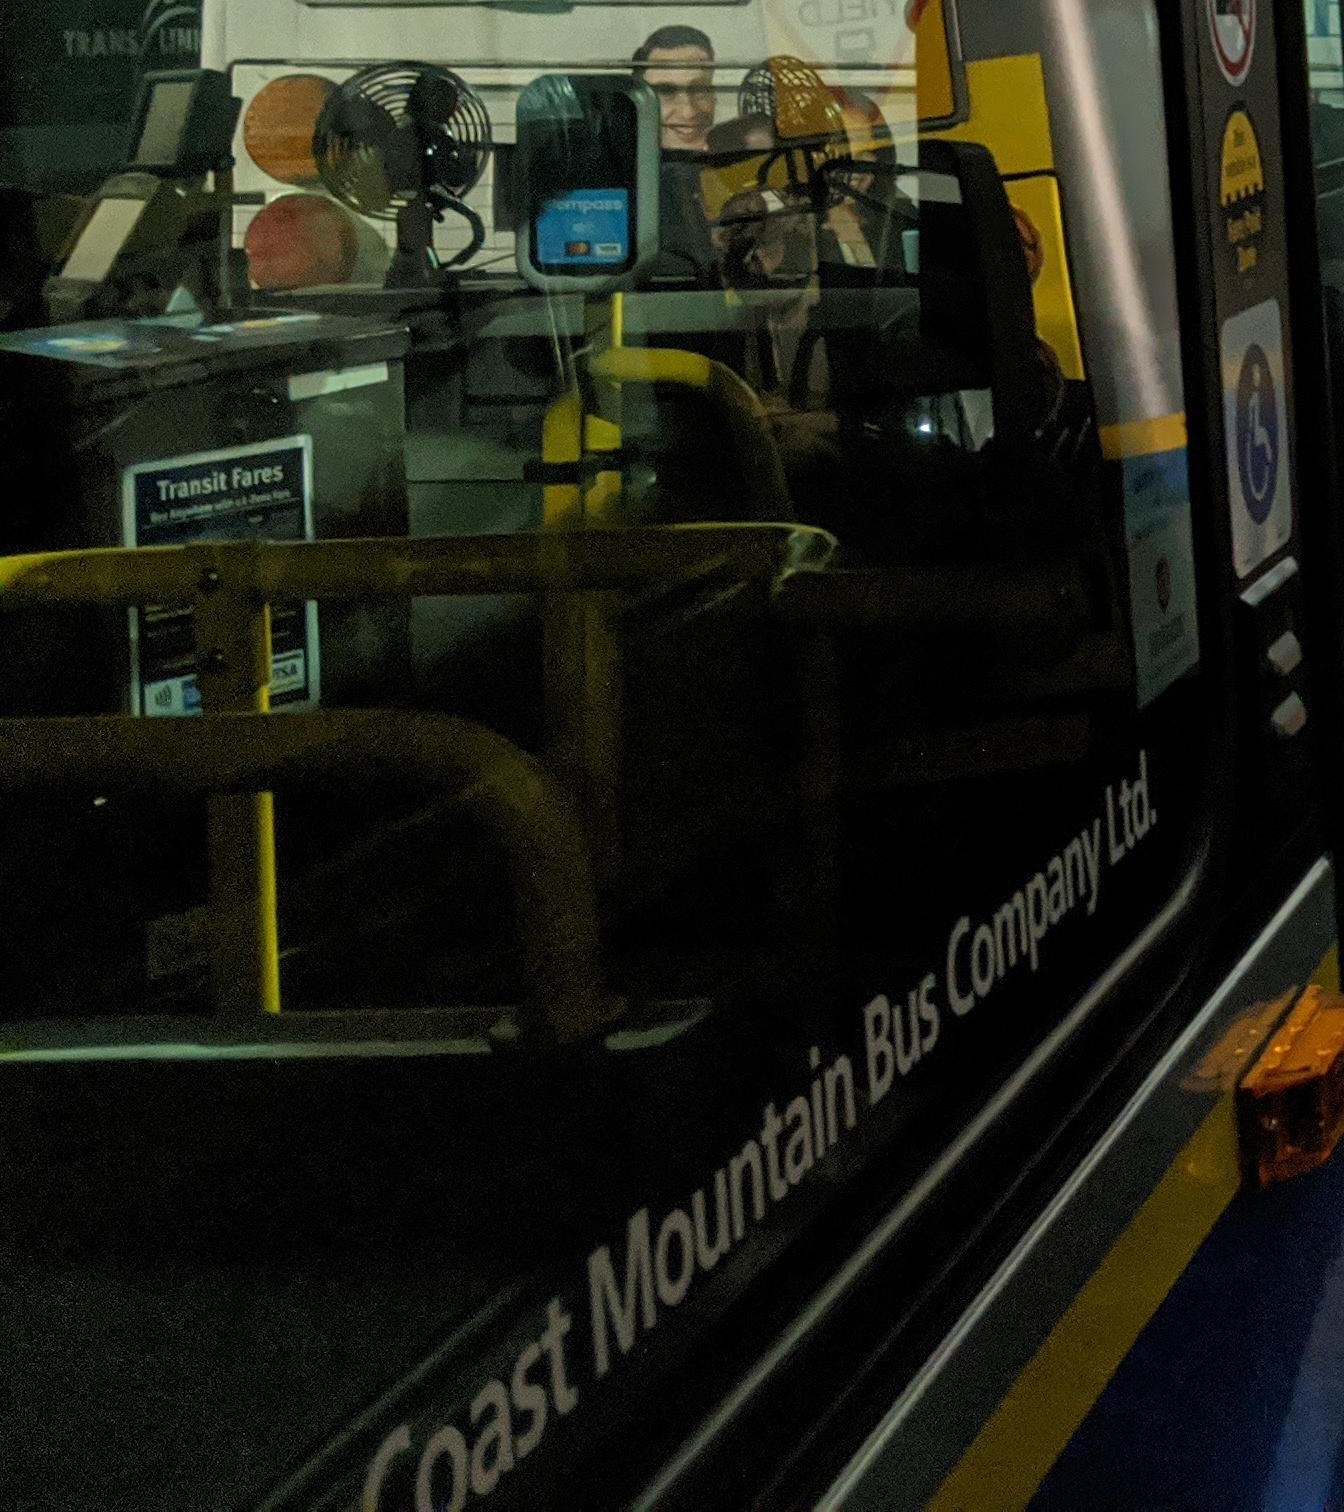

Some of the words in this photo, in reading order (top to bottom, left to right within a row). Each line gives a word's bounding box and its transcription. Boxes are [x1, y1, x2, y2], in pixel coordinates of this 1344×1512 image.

[156, 470, 228, 501] Transit
[231, 464, 284, 490] Fares
[362, 1295, 580, 1512] Coast
[586, 1044, 858, 1377] Mountain
[863, 972, 941, 1108] Bus
[944, 815, 1104, 1019] Company
[1105, 748, 1159, 867] Ltd.
